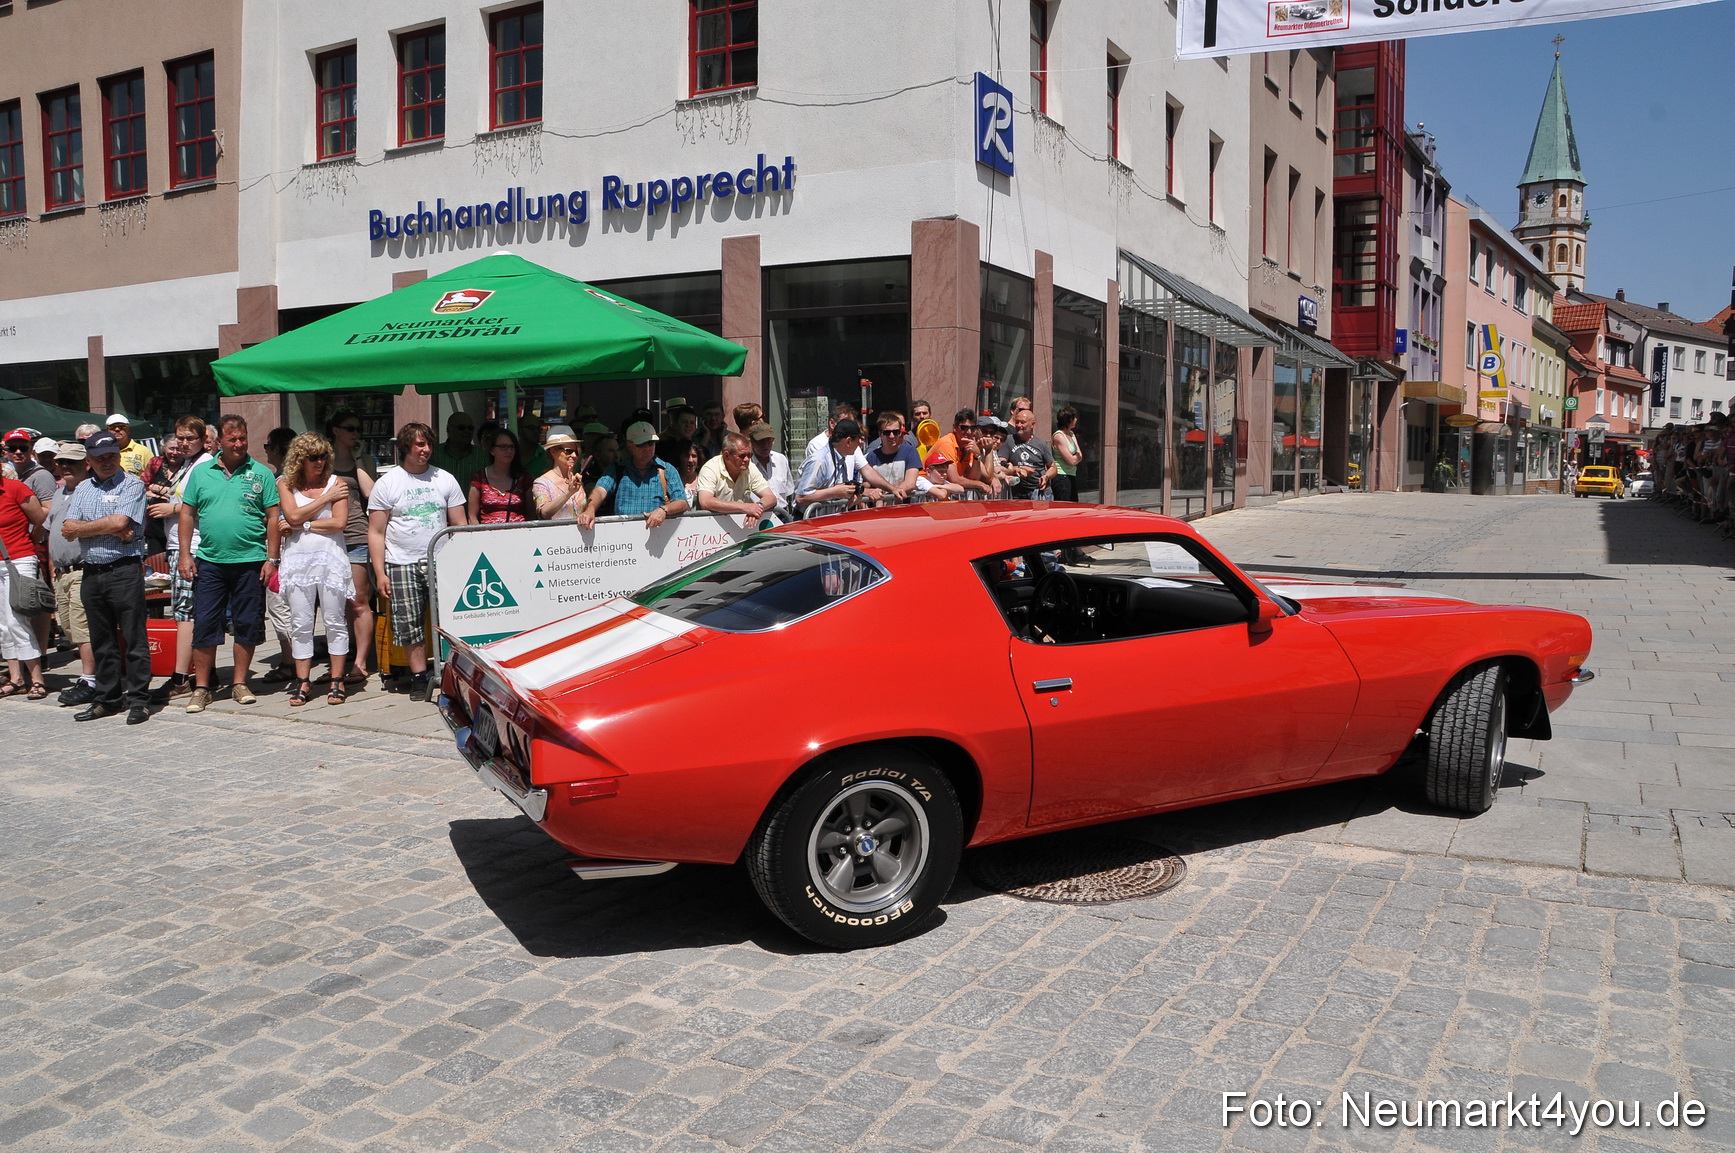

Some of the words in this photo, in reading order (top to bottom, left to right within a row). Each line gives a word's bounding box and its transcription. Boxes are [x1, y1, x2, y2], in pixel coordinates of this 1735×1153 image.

[1273, 22, 1303, 31] Neumarkter
[1303, 17, 1344, 30] Oldtimertreffen
[369, 186, 589, 241] Buchhandlung
[602, 153, 796, 216] Rupprecht
[379, 316, 509, 331] Neumarkter
[344, 324, 523, 345] Lammsbräu
[702, 532, 731, 546] UNS
[546, 542, 633, 556] Gebäudereinigung
[547, 557, 637, 572] Hausmeisterdienste
[548, 576, 601, 588] Mietservice
[452, 613, 463, 621] Jura
[464, 611, 486, 620] Gebäude
[504, 608, 520, 616] GmbH
[841, 767, 907, 787] Radial
[910, 778, 933, 802] T/A
[805, 884, 915, 927] BFGoodrich
